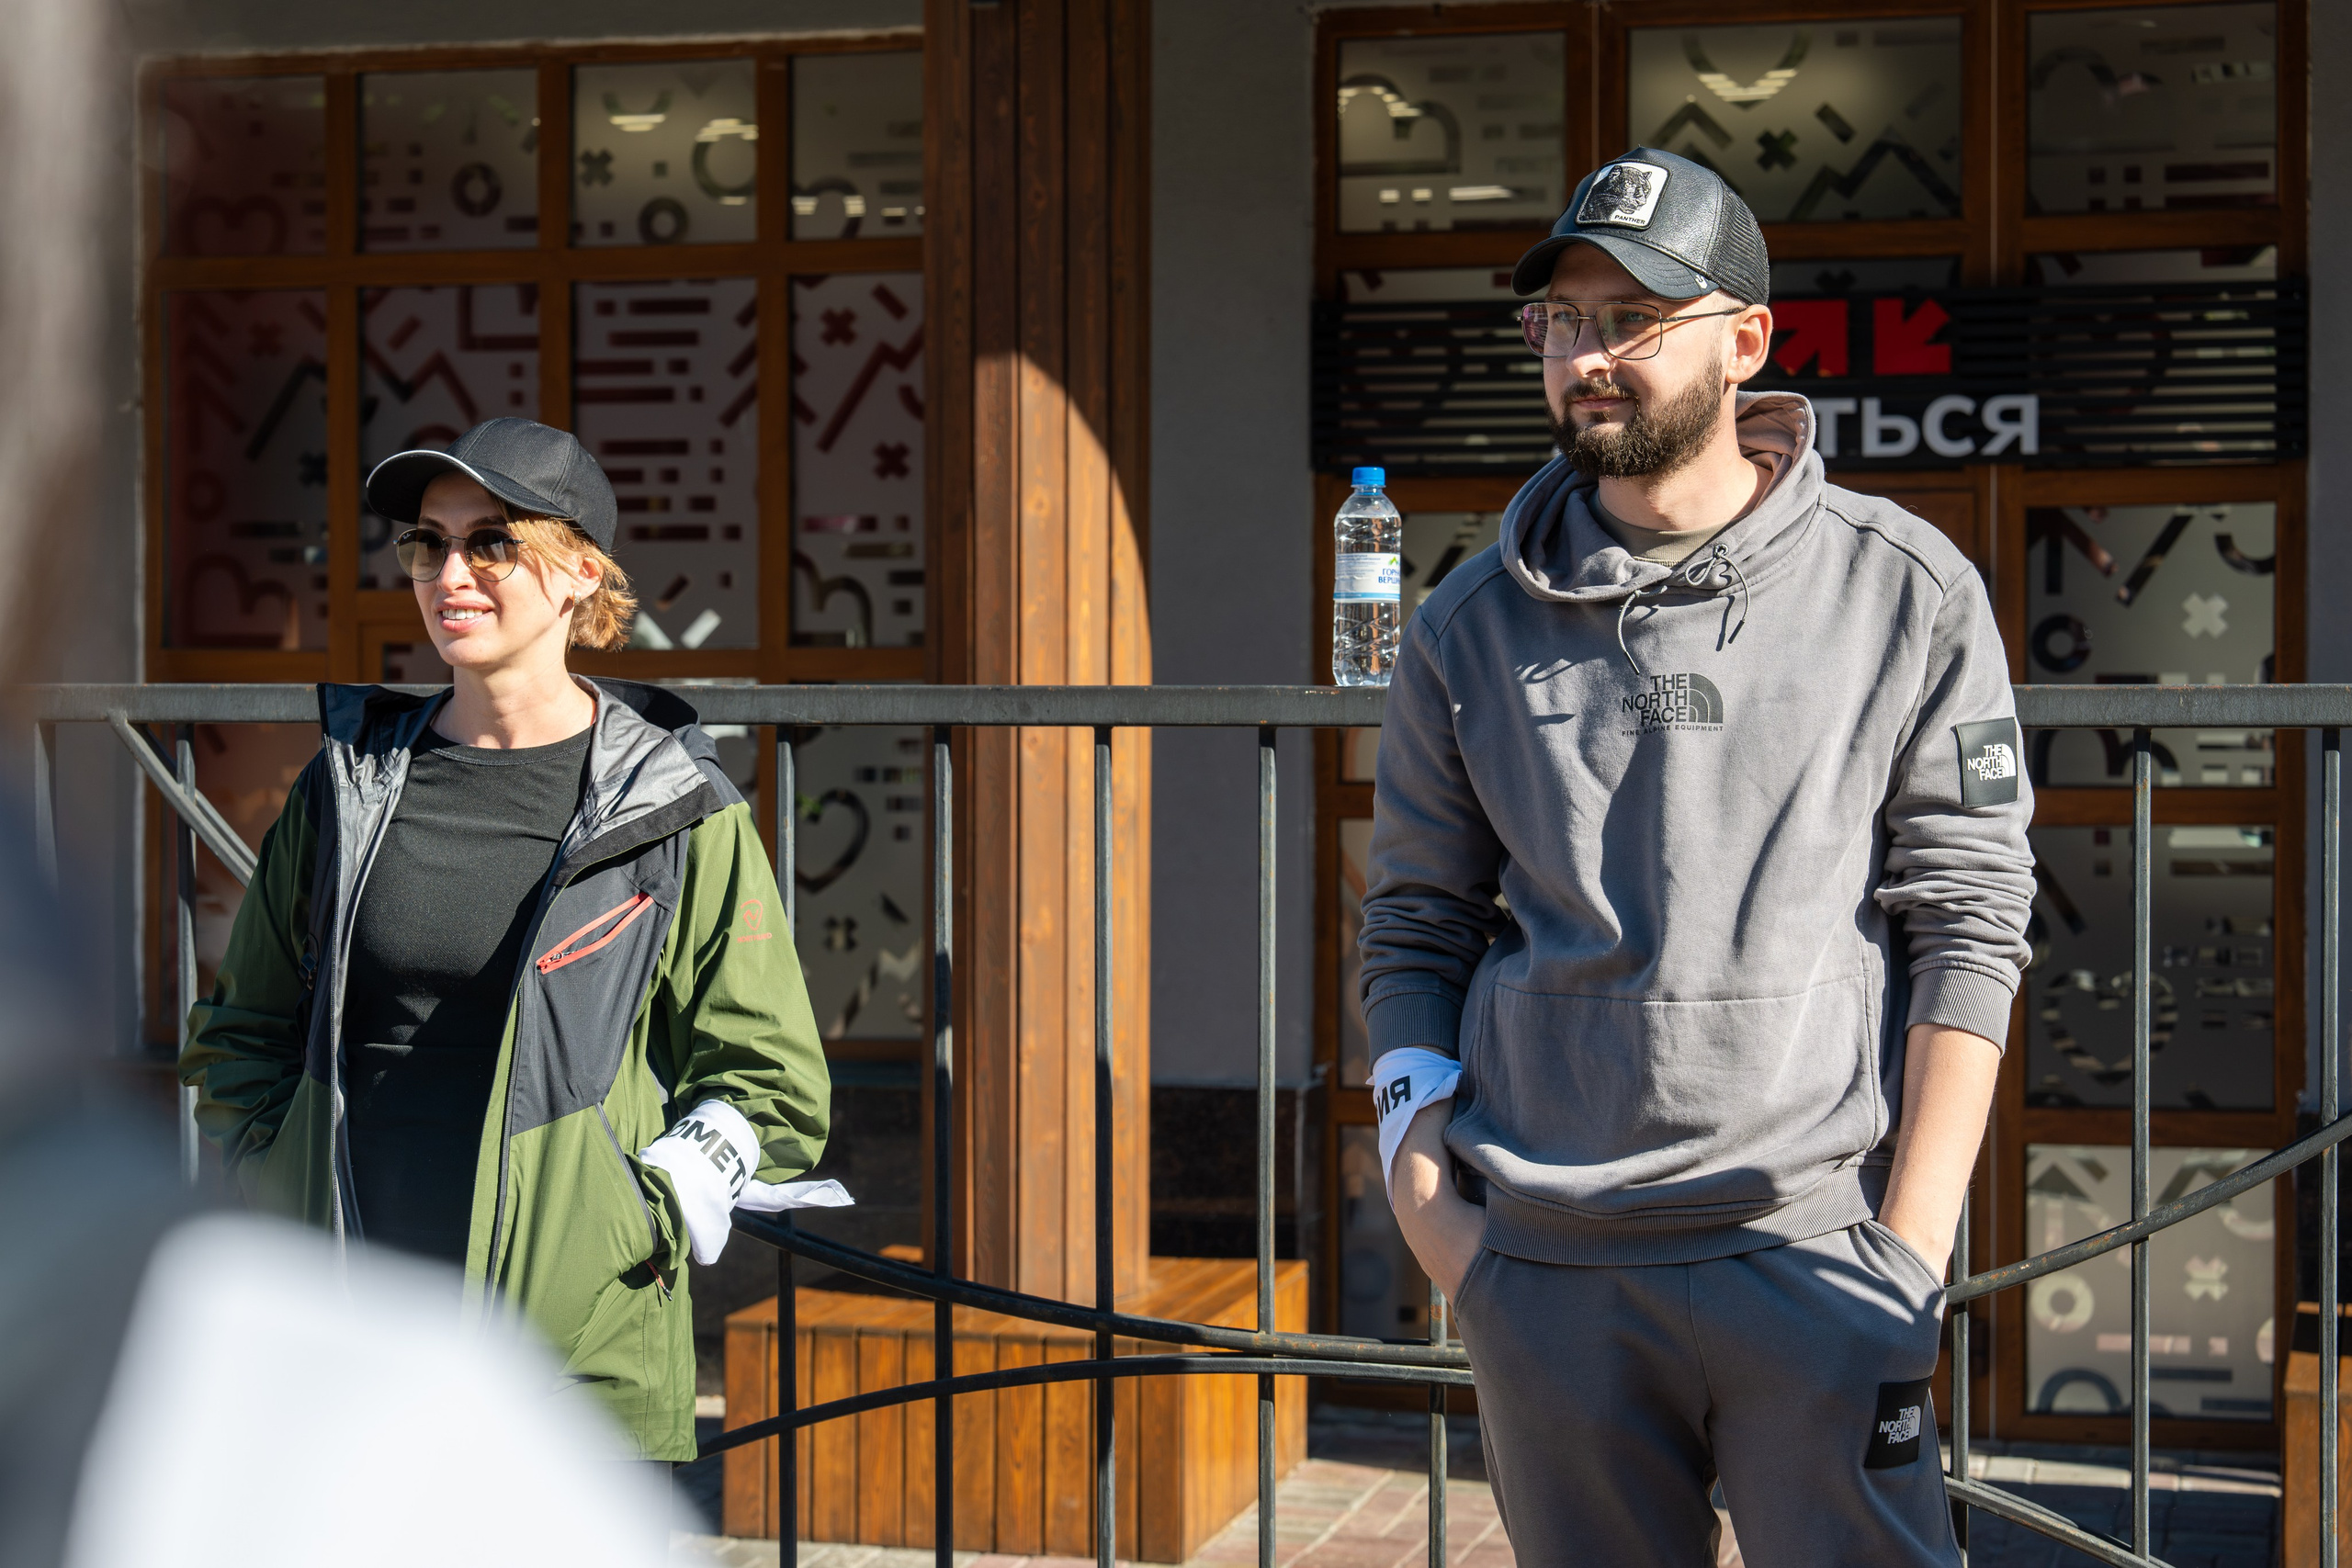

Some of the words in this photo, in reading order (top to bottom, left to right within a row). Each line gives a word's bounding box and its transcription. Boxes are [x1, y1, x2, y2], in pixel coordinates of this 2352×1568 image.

[1614, 215, 1645, 225] PANTHER
[1813, 394, 2040, 458] ТЬСЯ
[1650, 673, 1688, 691] THE
[1622, 690, 1688, 713] NORTH
[1640, 706, 1688, 727] FACE
[1643, 725, 1671, 735] ALPINE
[1675, 724, 1724, 732] EQUIPMENT
[1983, 744, 2003, 757] THE
[1967, 756, 2002, 771] NORTH
[1979, 767, 2003, 781] FACE
[1898, 1407, 1914, 1420] THE
[1879, 1419, 1911, 1433] NORTH
[1887, 1430, 1911, 1444] FACE
